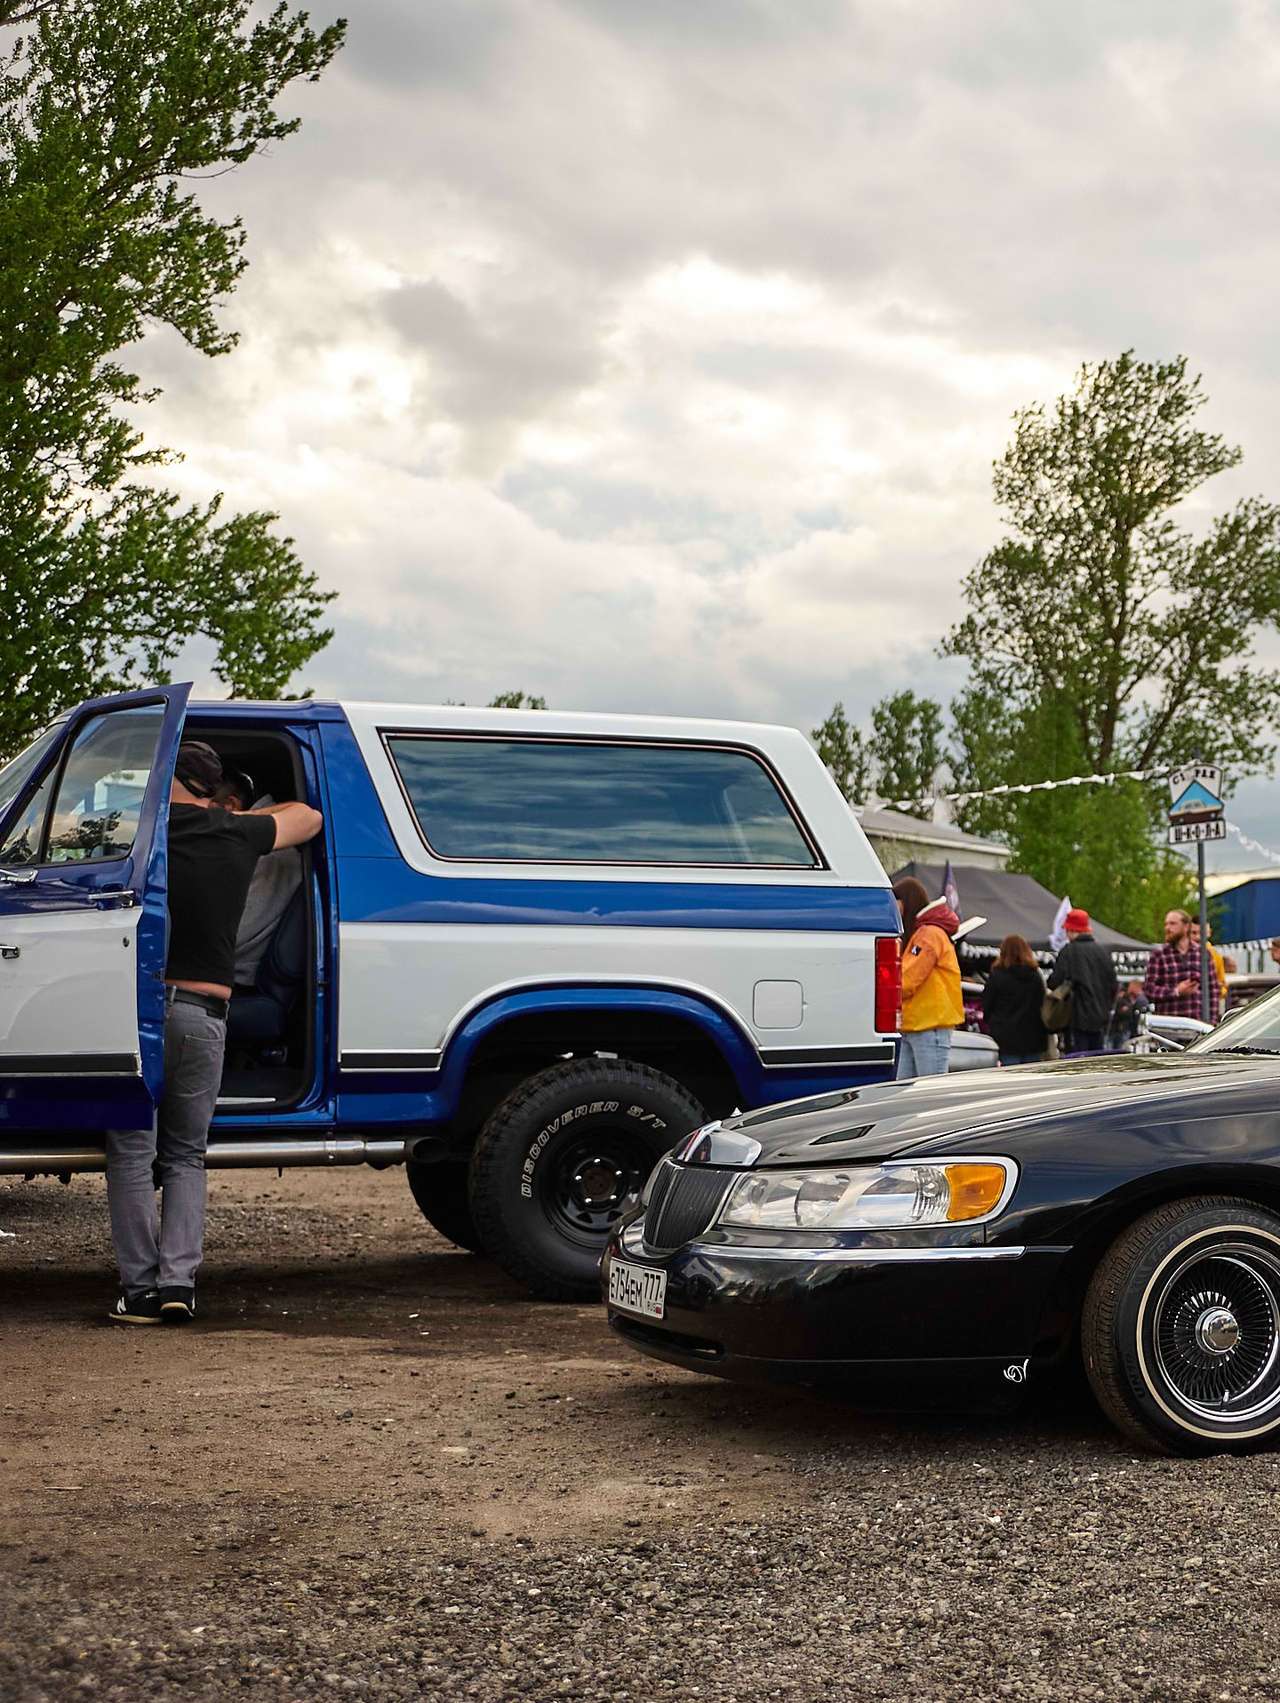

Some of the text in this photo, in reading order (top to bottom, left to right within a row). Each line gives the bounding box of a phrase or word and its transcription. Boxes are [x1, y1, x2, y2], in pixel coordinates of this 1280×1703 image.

[521, 1101, 667, 1198] DISCOVERER S/T
[644, 1272, 661, 1302] 777
